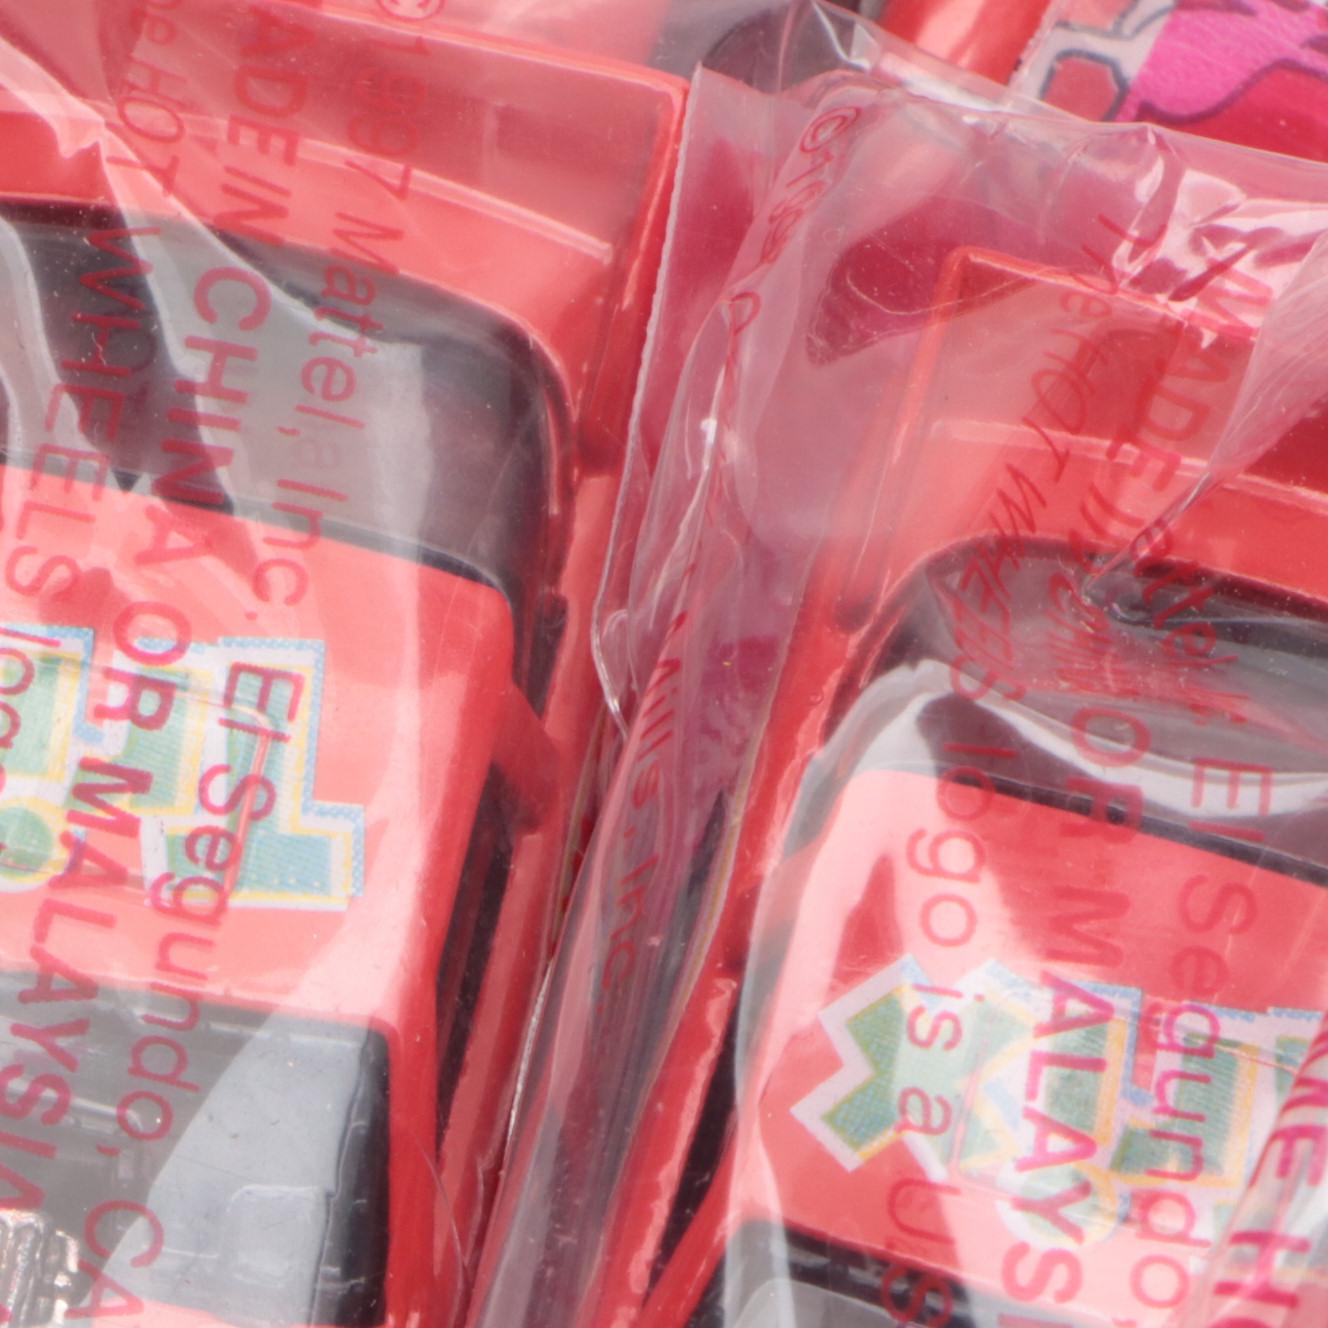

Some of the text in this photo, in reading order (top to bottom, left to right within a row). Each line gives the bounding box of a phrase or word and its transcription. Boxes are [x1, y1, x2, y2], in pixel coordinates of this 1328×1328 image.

[107, 62, 191, 197] HOT
[213, 167, 291, 246] IN
[282, 212, 402, 436] Mattel,
[6, 228, 152, 595] WHEELS
[139, 267, 272, 563] CHINA
[246, 481, 348, 620] Inc.
[98, 608, 190, 730] OR
[224, 661, 300, 740] El
[1067, 711, 1148, 832] OR
[1189, 760, 1273, 840] El
[907, 741, 1024, 943] logo
[100, 764, 275, 1156] Segundo,
[906, 983, 985, 1050] is
[898, 1088, 954, 1137] a
[1113, 875, 1257, 1326] Segundo,
[68, 1200, 164, 1319] CA
